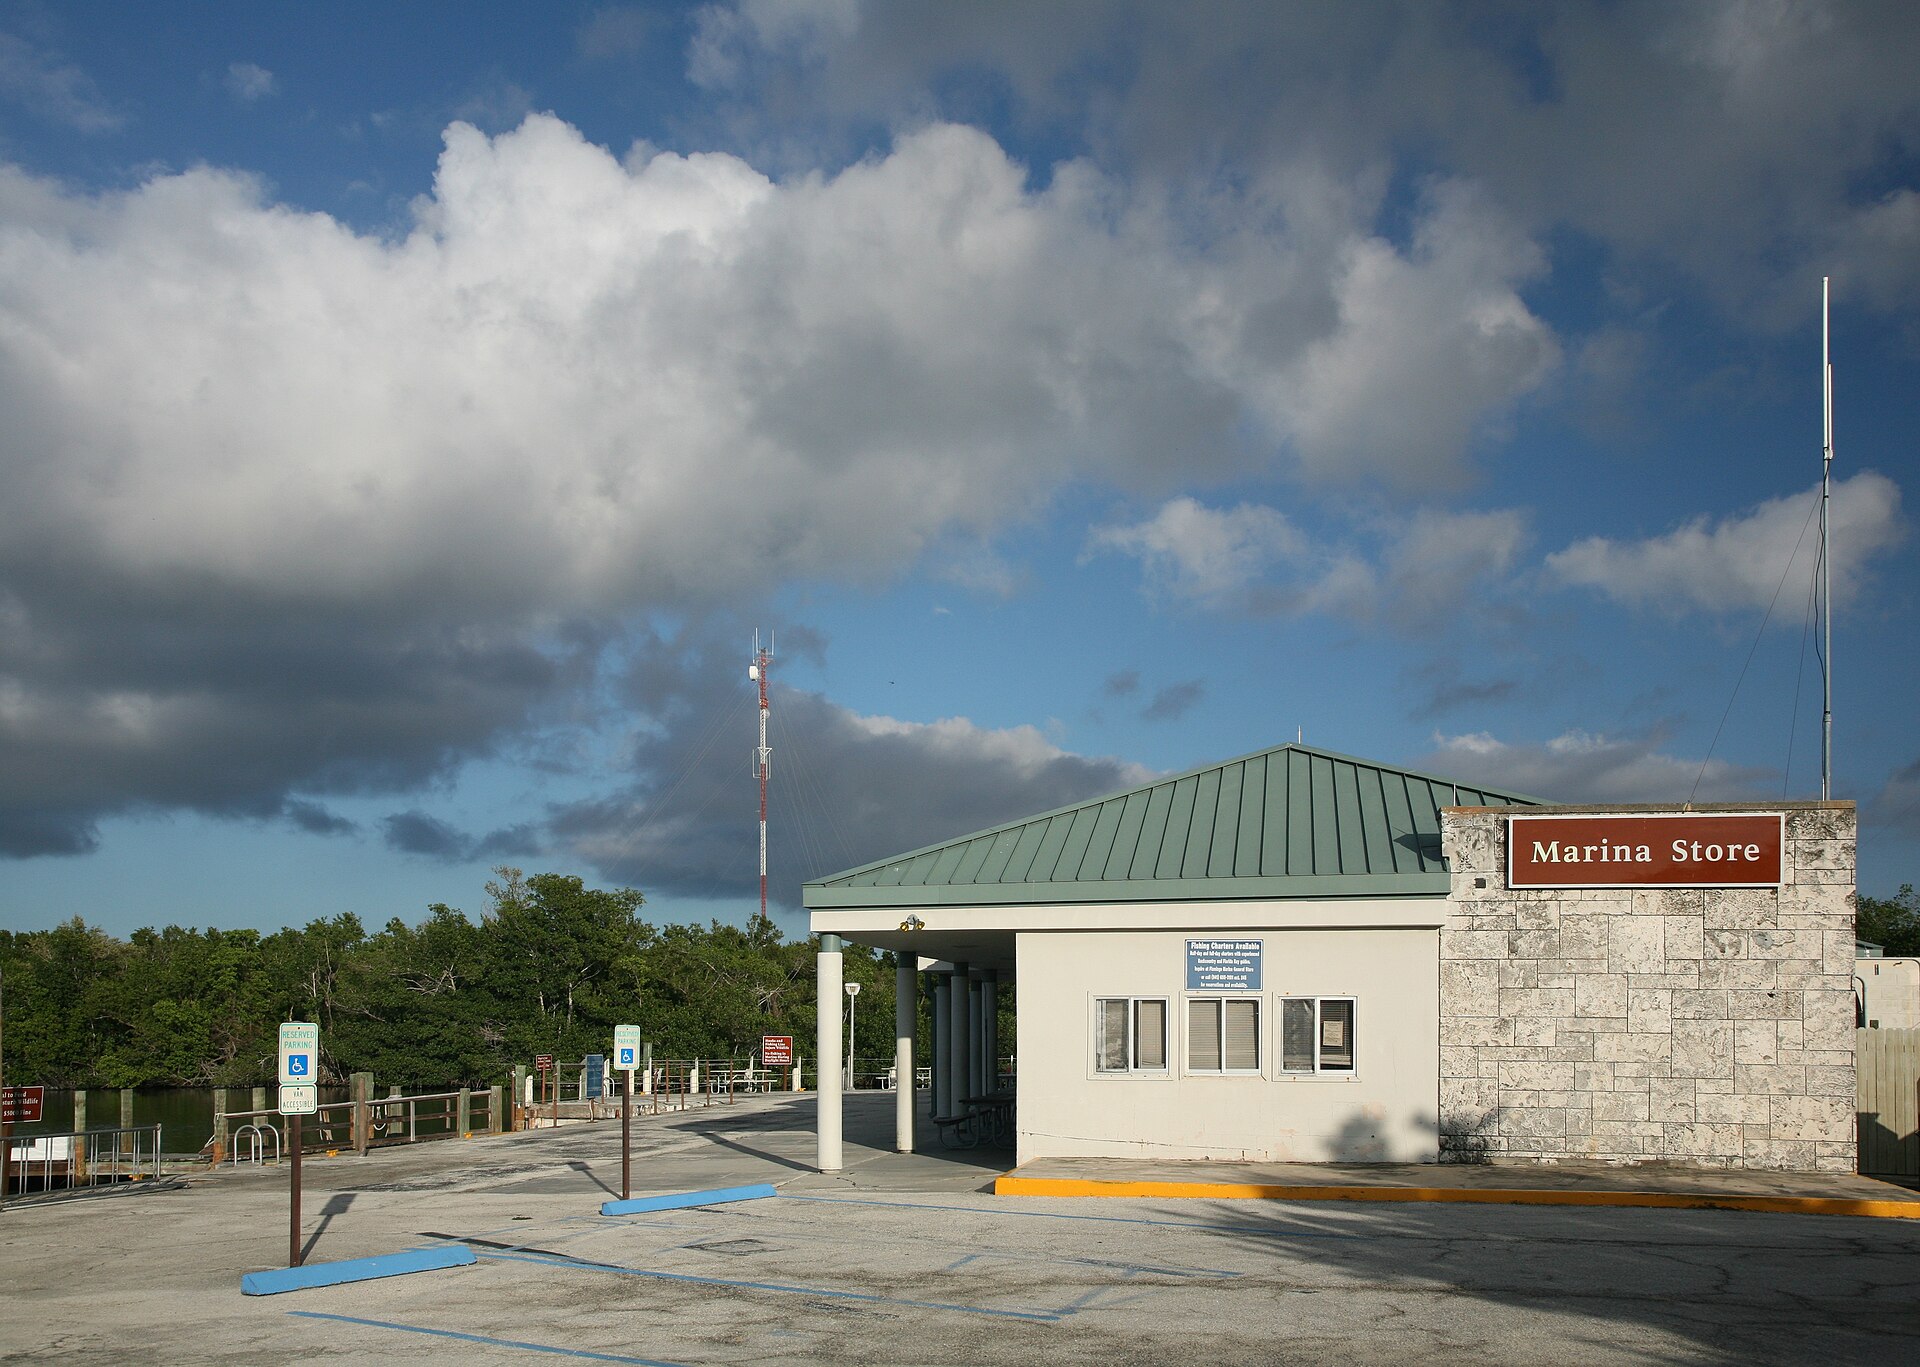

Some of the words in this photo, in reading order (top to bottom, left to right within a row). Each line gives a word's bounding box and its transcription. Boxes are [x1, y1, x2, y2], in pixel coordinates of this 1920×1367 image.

[1531, 838, 1652, 863] Marina
[1671, 839, 1760, 862] Store
[1191, 942, 1209, 950] Fishing
